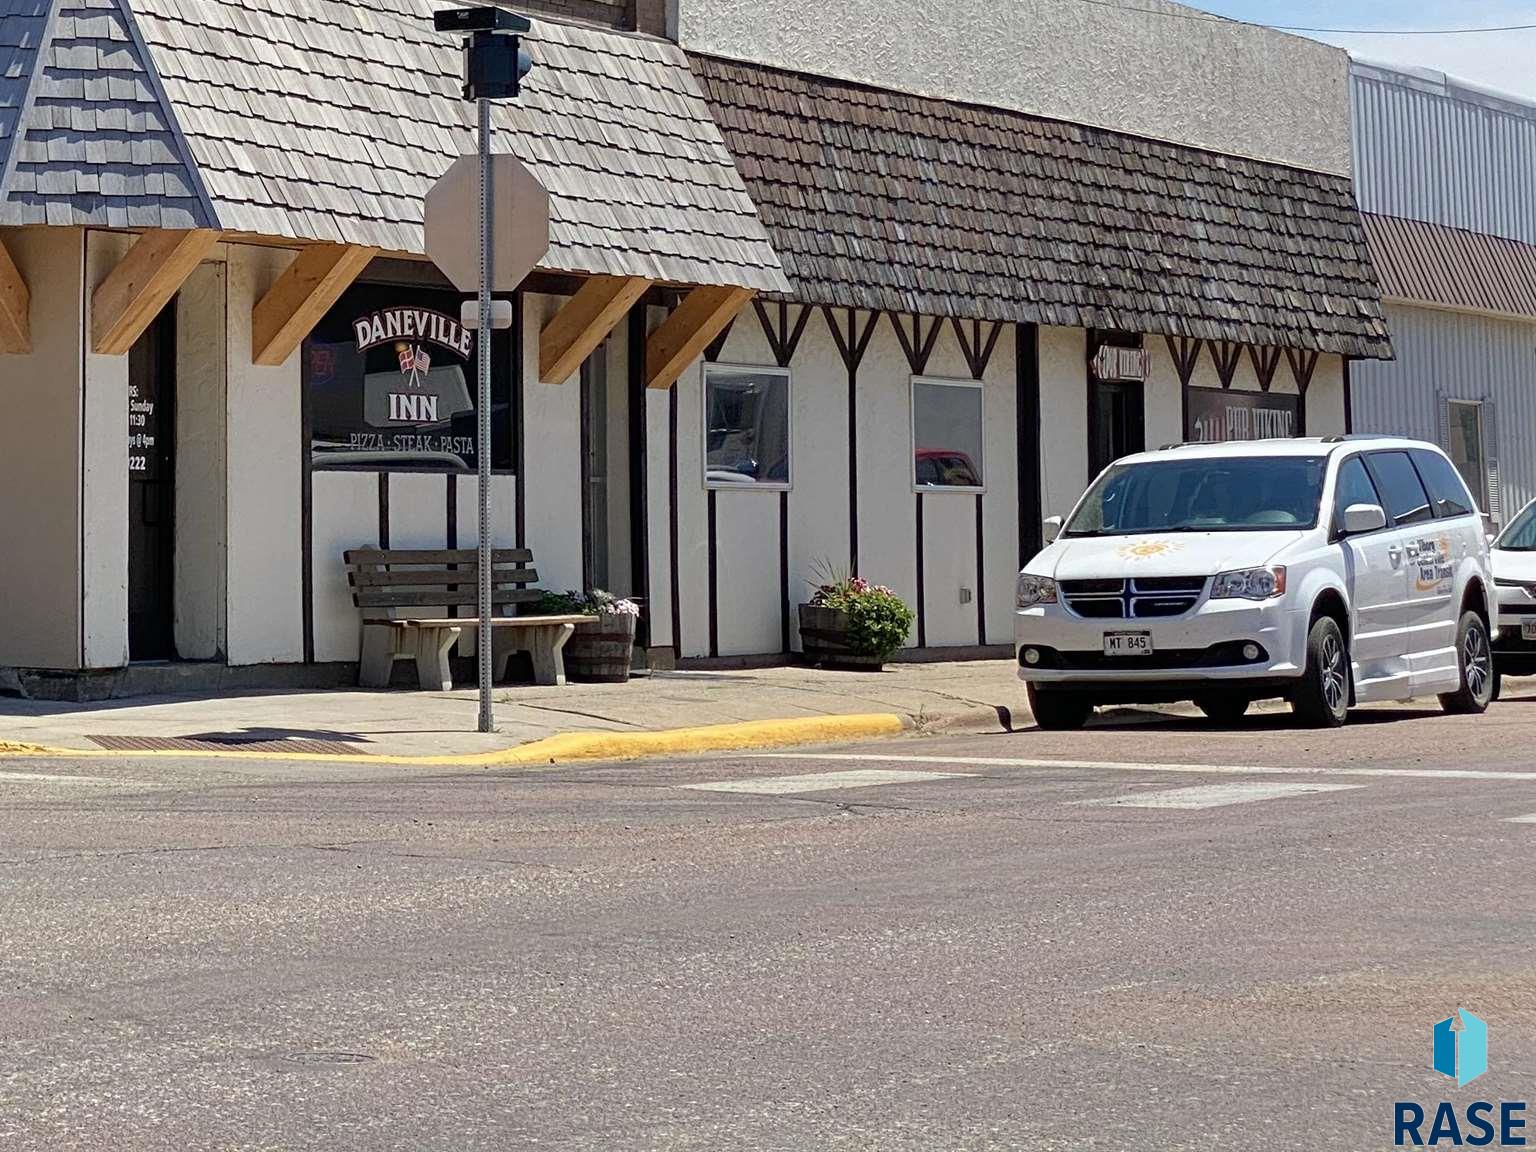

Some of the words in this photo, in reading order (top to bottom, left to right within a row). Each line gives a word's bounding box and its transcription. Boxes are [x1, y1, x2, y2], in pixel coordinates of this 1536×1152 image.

[355, 310, 471, 356] DANEVILLE
[130, 399, 154, 416] Sunday
[388, 393, 438, 421] INN
[129, 414, 146, 426] 11:30
[350, 432, 384, 451] PIZZA
[393, 434, 433, 453] STEAK
[440, 436, 475, 455] PASTA
[1127, 636, 1146, 649] 845
